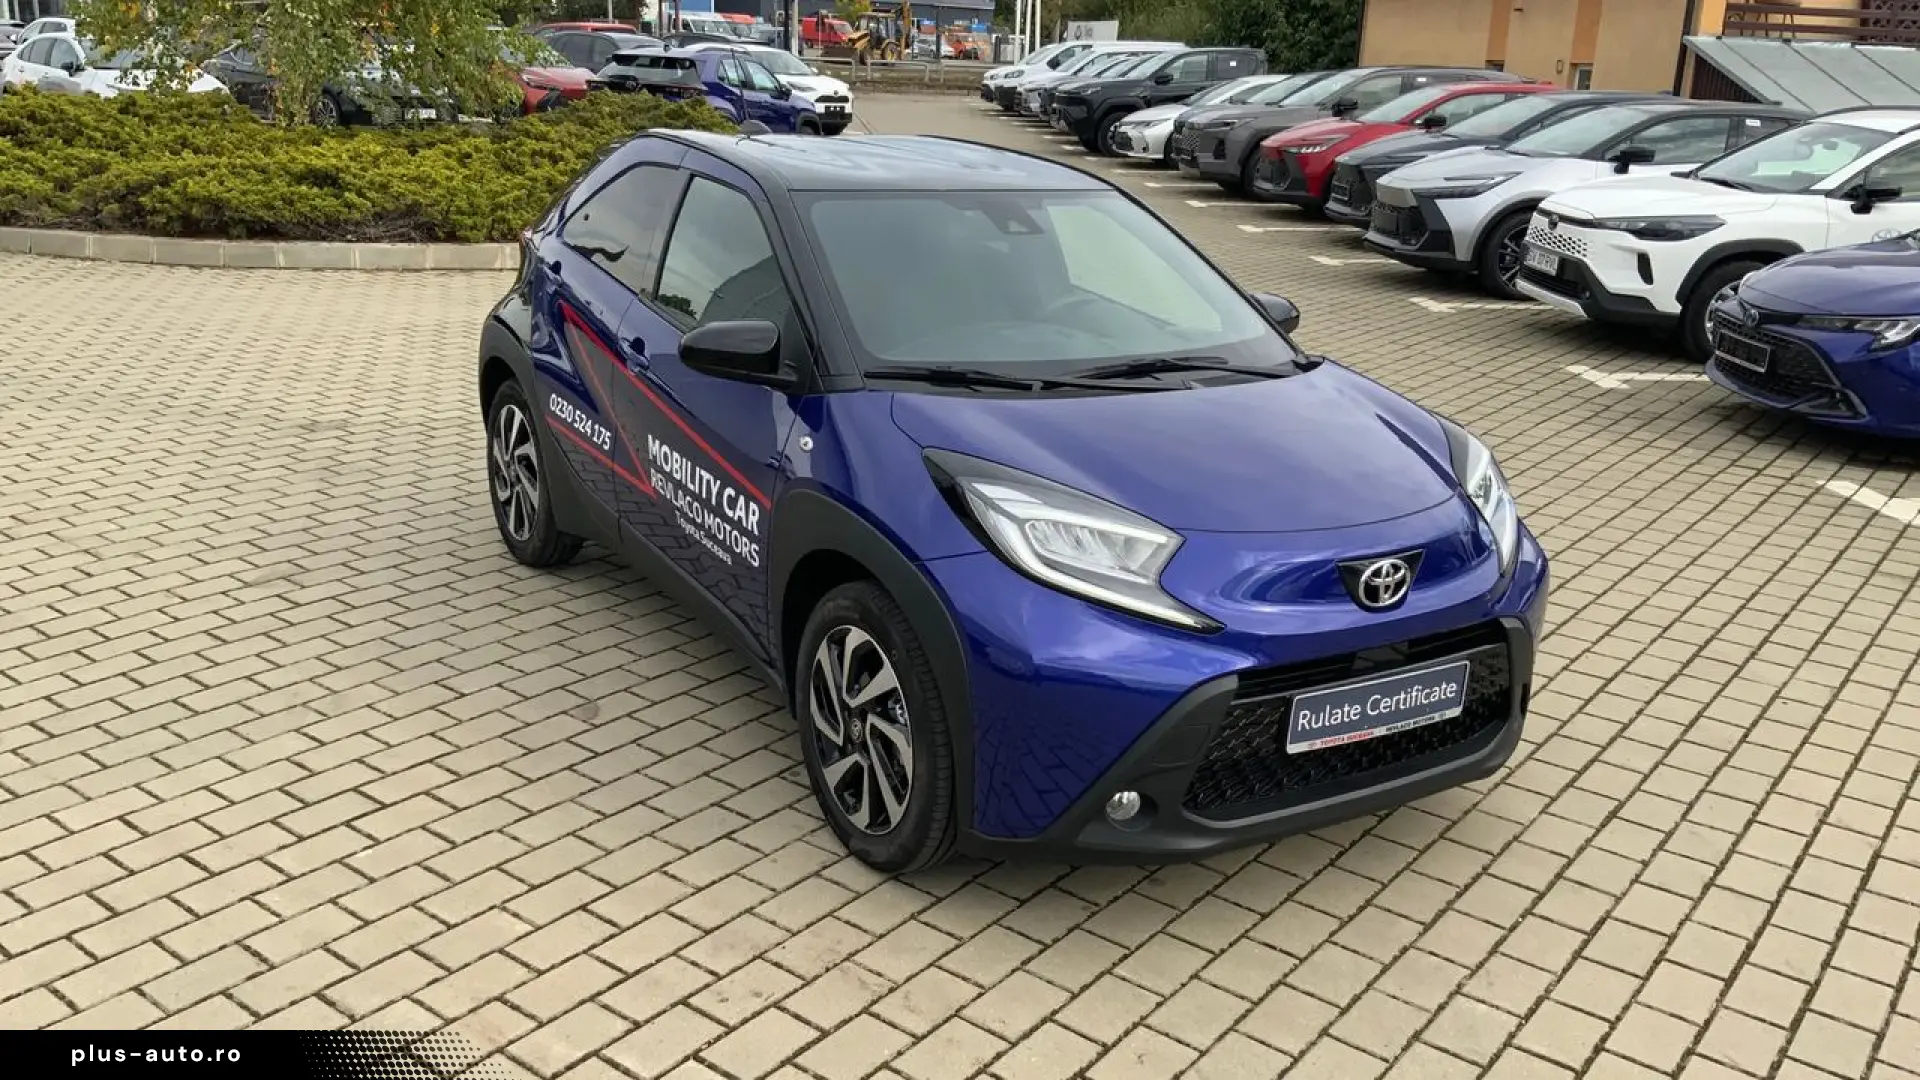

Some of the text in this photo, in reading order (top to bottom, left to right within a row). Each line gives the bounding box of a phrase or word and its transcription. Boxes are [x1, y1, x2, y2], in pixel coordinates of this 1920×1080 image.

[549, 393, 612, 451] 0230 524 175
[647, 433, 760, 536] MOBILITY CAR
[650, 467, 760, 568] REVLACO MOTORS
[675, 509, 733, 565] Toyota Suceava
[1298, 681, 1458, 732] Rulate Certificate
